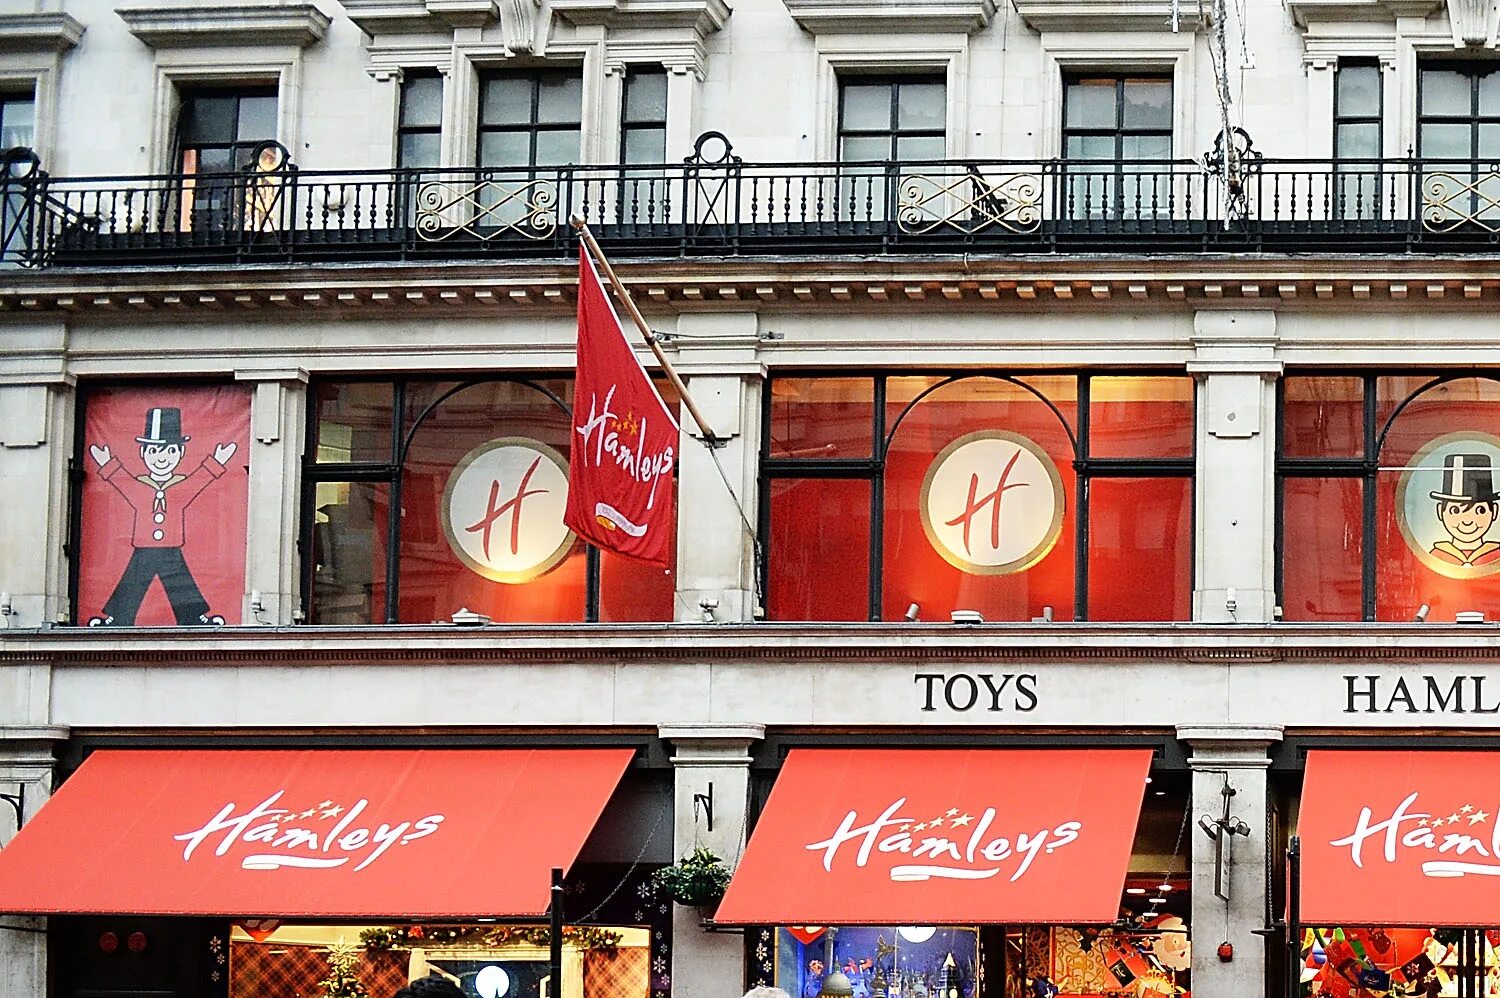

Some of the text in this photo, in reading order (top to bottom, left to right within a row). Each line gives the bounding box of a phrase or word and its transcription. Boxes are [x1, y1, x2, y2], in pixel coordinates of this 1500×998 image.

[576, 384, 680, 510] Hamleys
[914, 673, 1038, 712] TOYS
[174, 790, 445, 872] Hamleys
[806, 797, 1082, 882] Hamleys
